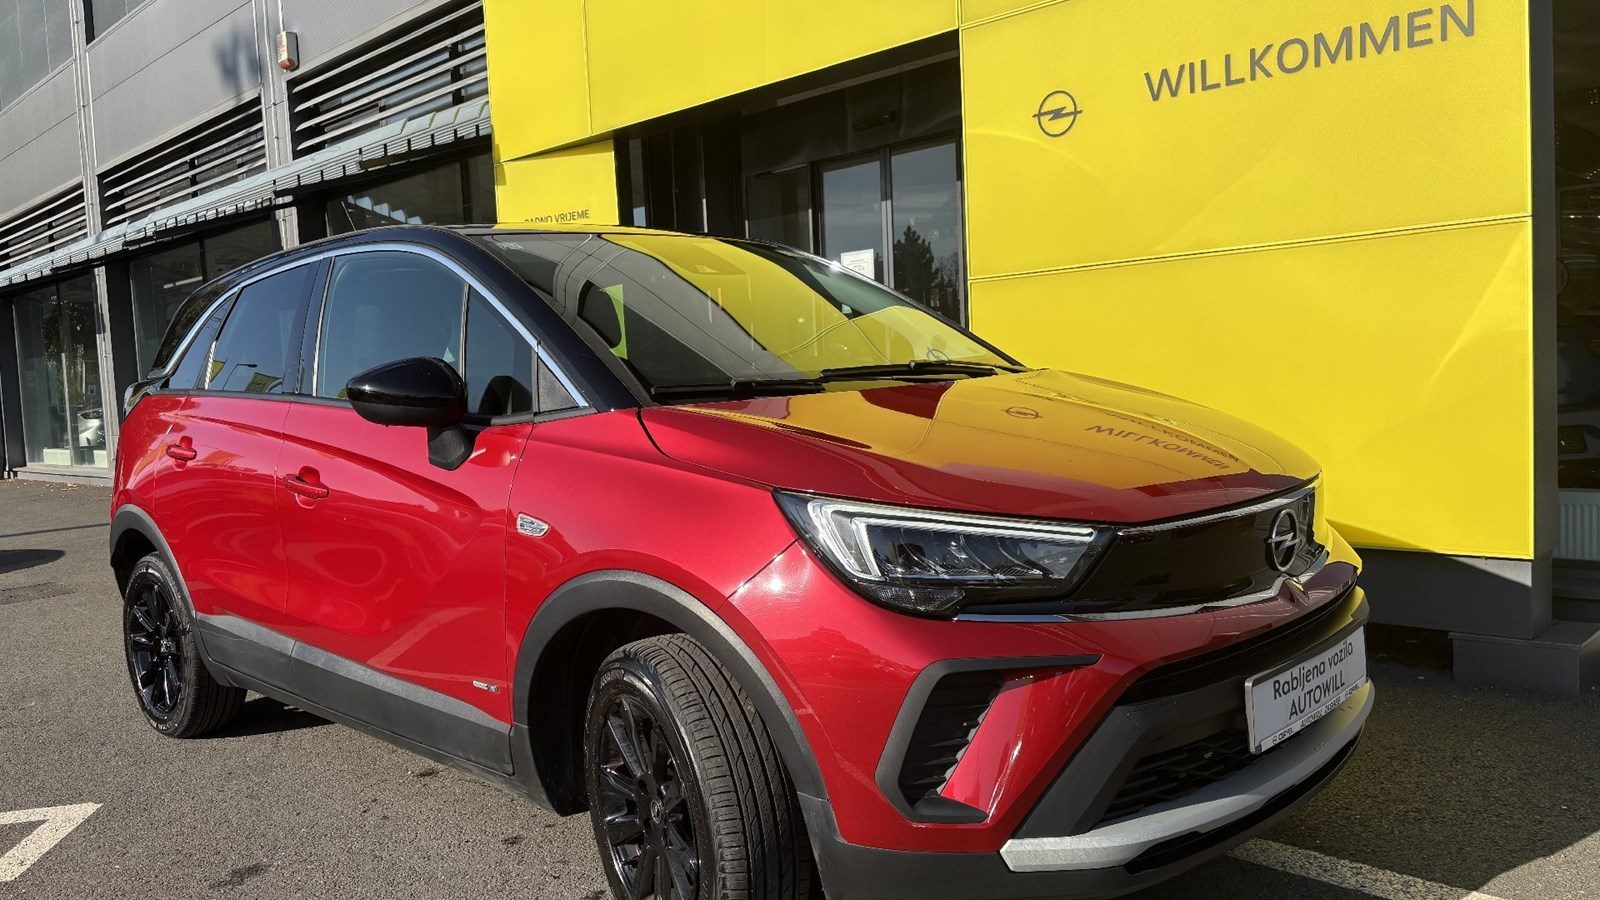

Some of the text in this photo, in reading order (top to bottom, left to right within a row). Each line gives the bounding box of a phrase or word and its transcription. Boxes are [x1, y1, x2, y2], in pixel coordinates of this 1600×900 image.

[1145, 0, 1476, 102] WILLKOMMEN
[554, 209, 590, 223] VRIJEME
[1273, 641, 1353, 700] Rabljena vozila
[1289, 671, 1345, 720] AUTOWILL
